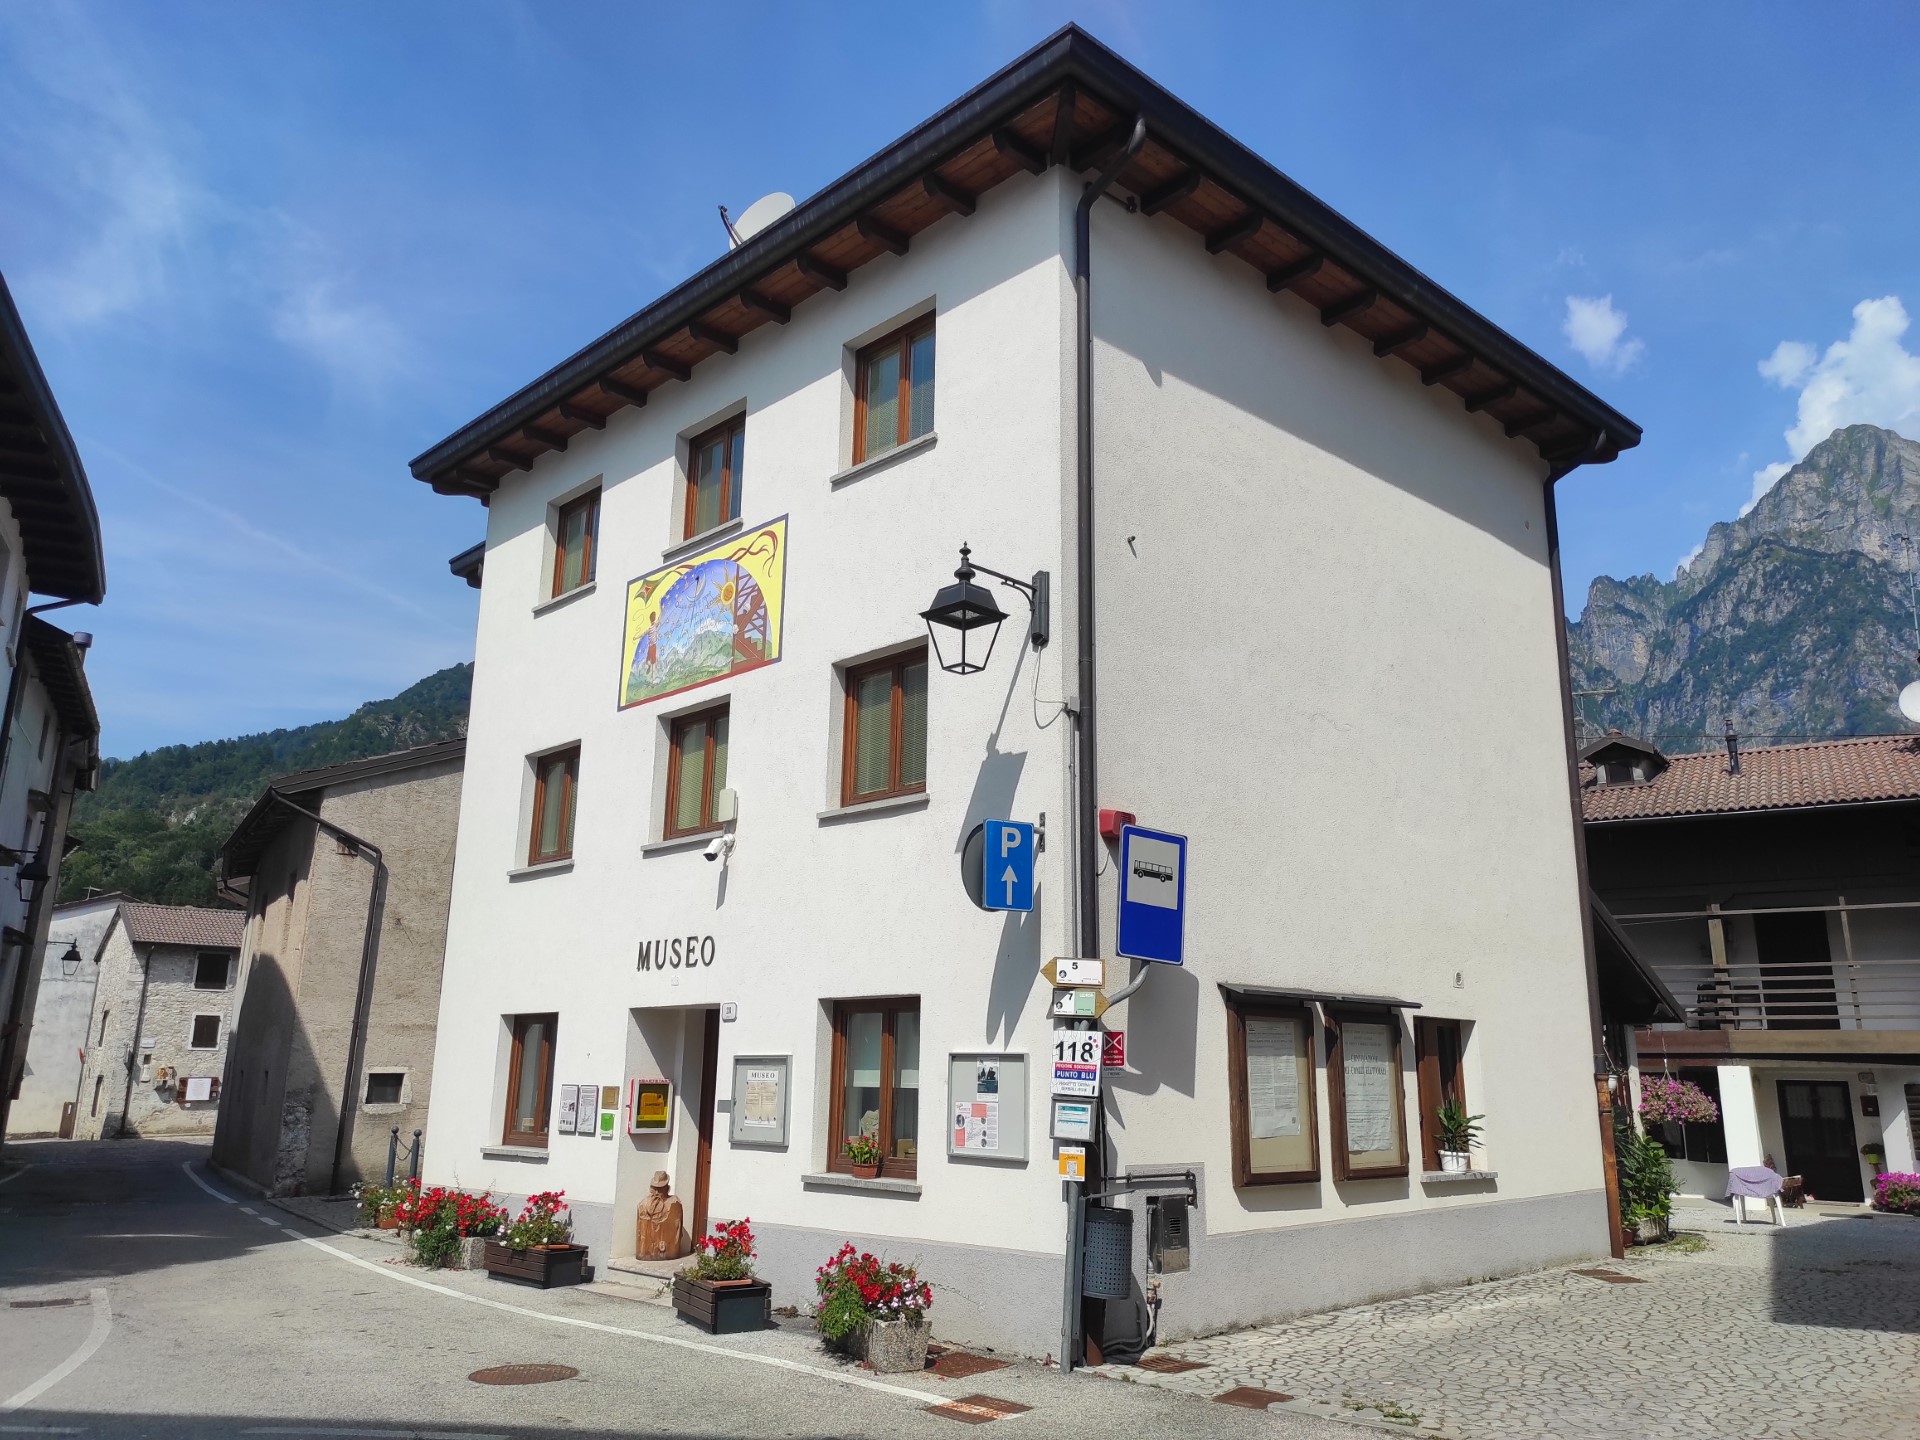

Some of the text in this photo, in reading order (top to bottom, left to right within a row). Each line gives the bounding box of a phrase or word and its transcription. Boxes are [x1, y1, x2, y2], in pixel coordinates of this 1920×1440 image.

[1001, 826, 1021, 858] P
[636, 935, 716, 972] MUSEO
[1071, 962, 1079, 970] 5
[1068, 992, 1073, 1001] 7
[1055, 1041, 1093, 1062] 118
[1056, 1071, 1095, 1080] PUNTO BLU
